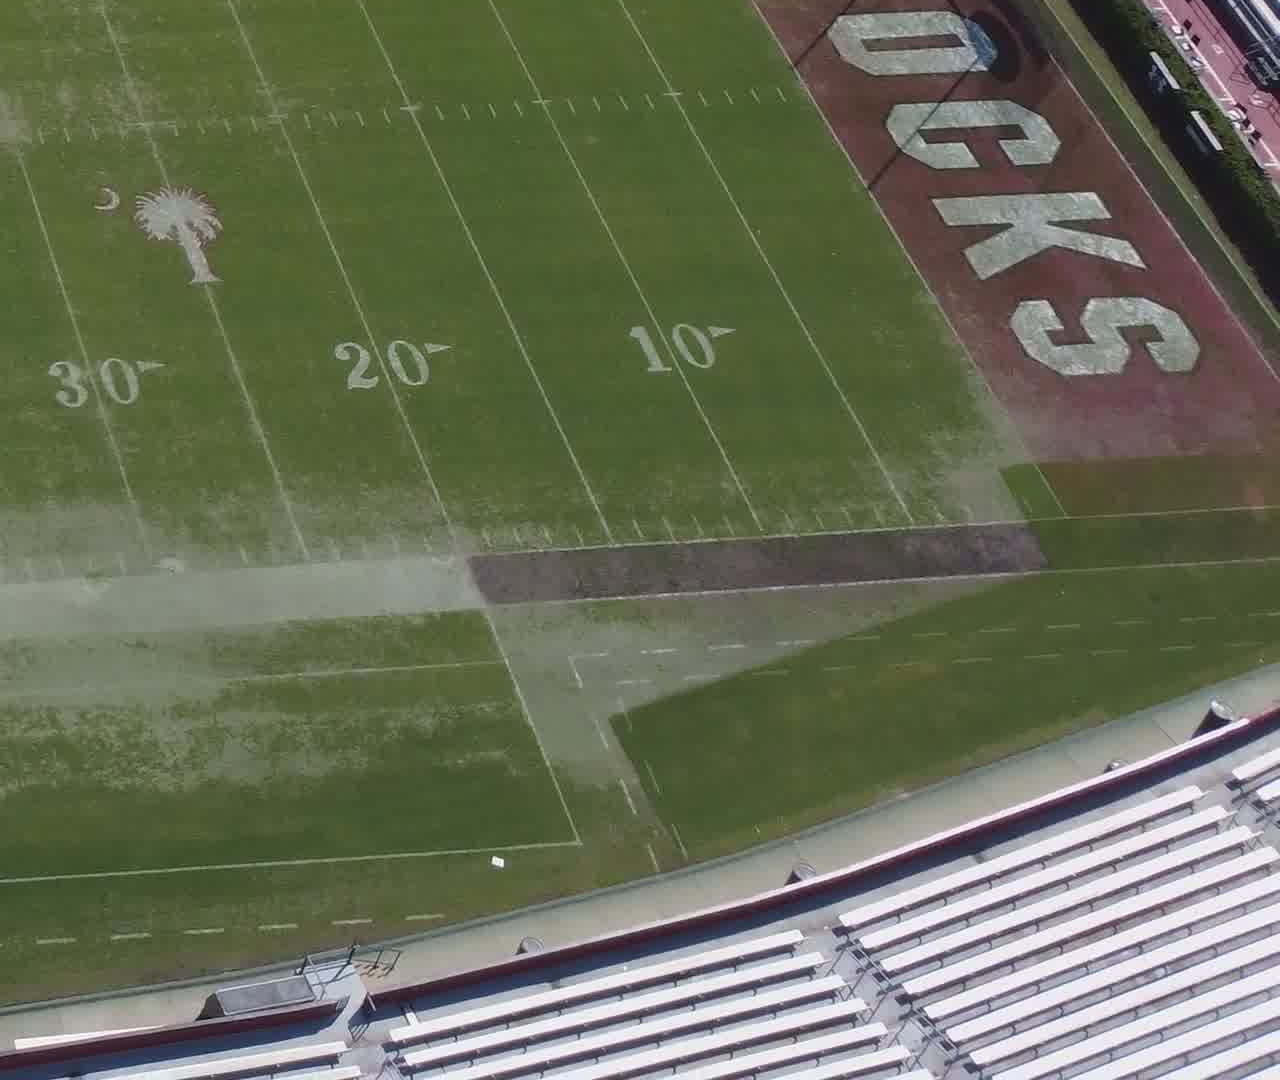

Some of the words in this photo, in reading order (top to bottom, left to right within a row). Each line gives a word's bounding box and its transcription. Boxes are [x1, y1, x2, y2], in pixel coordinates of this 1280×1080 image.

[333, 338, 432, 390] 20
[629, 321, 718, 374] 10
[47, 356, 142, 409] 30
